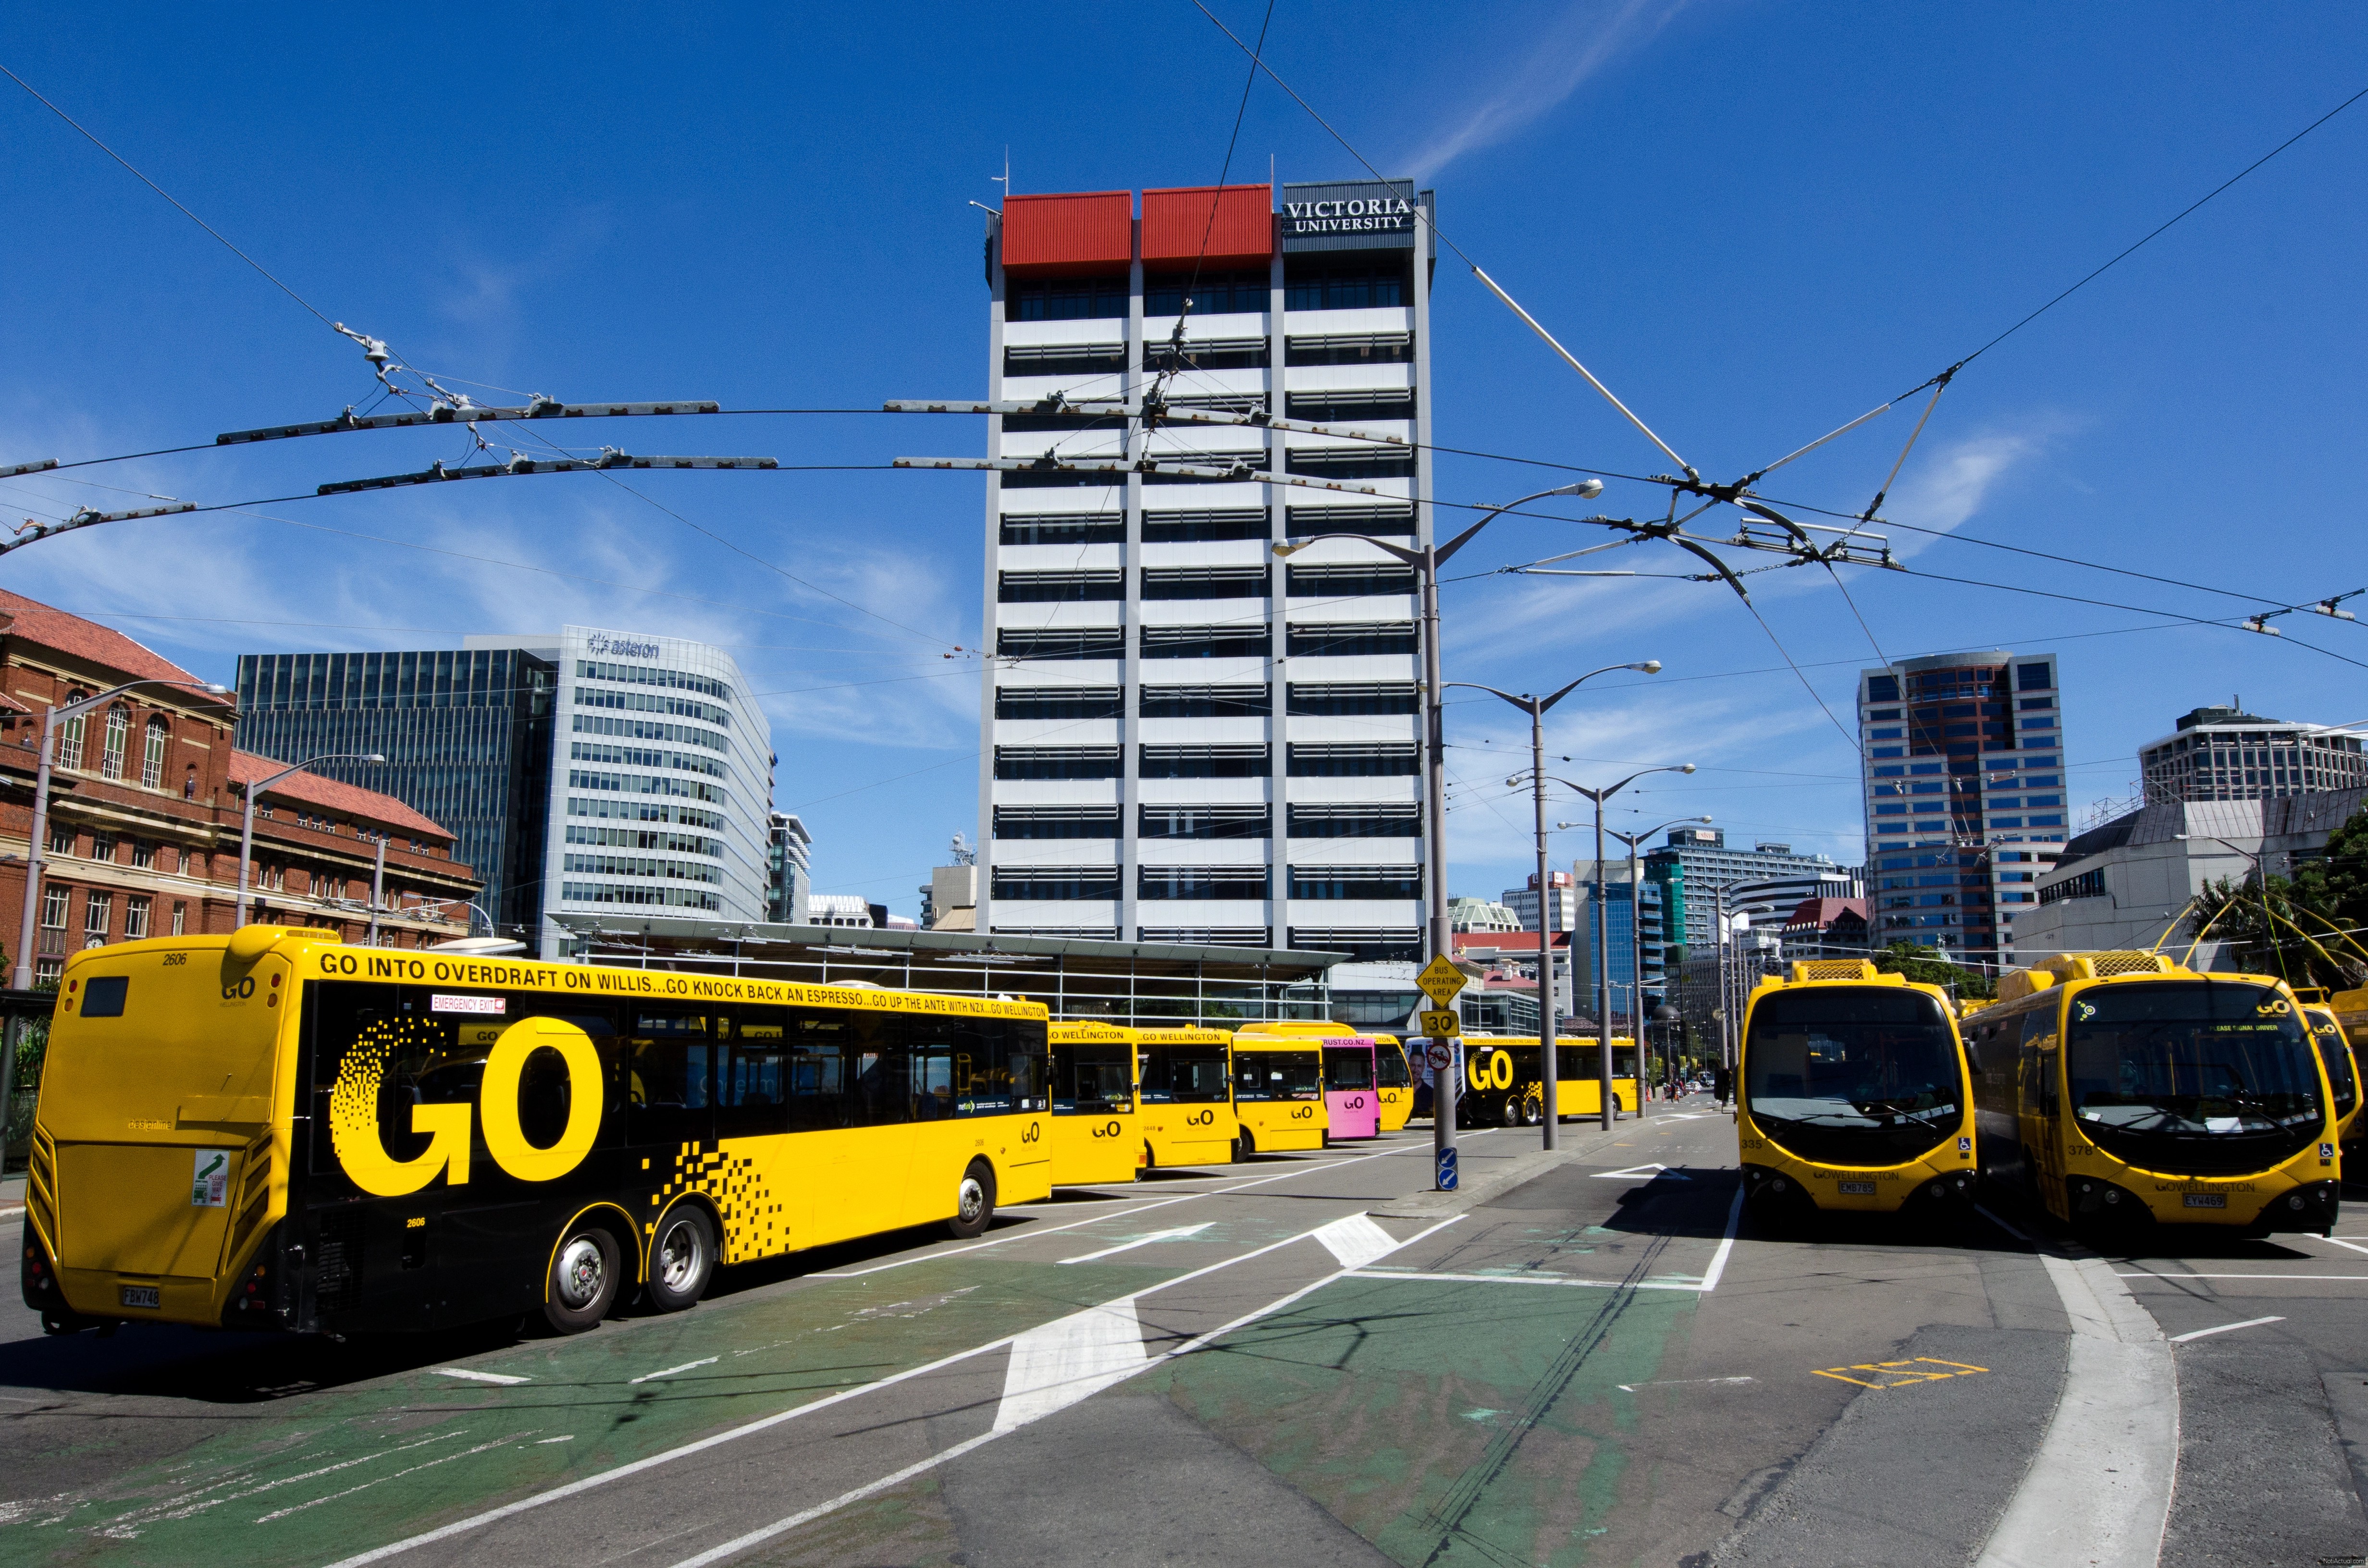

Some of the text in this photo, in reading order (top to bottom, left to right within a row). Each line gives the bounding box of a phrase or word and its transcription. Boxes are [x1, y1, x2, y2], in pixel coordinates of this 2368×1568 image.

[1286, 198, 1410, 218] VICTORIA
[1295, 217, 1403, 232] UNIVERSITY
[611, 638, 659, 659] asteron
[162, 953, 187, 966] 2606
[222, 976, 255, 999] GO
[321, 953, 358, 974] GO
[368, 957, 425, 979] INTO
[434, 962, 557, 987] OVERDRAFT
[565, 971, 591, 989] ON
[693, 980, 743, 998] KNOCK
[747, 985, 783, 1000] BACK
[787, 988, 803, 1002] AN
[889, 996, 902, 1008] UP
[904, 997, 922, 1009] THE
[925, 999, 946, 1011] ANTE
[948, 1000, 967, 1012] WITH
[1003, 1004, 1046, 1017] WELLINGTON
[1423, 977, 1461, 985] OPERATING
[1432, 988, 1451, 996] AREA
[434, 997, 493, 1011] EMERGENCY EXIT
[2257, 1000, 2291, 1014] GO
[1428, 1016, 1452, 1031] 30
[2313, 1024, 2336, 1033] GO
[477, 1031, 498, 1041] GO
[1468, 1050, 1513, 1090] GO
[1344, 1097, 1364, 1109] GO
[1379, 1092, 1397, 1103] GO
[330, 1016, 604, 1196] GO
[1291, 1106, 1312, 1119] GO
[129, 1118, 172, 1130] designline
[1186, 1109, 1214, 1126] GO
[1022, 1121, 1040, 1144] GO
[1092, 1121, 1121, 1138] GO
[1741, 1139, 1762, 1149] 335
[2068, 1145, 2093, 1156] 378
[1841, 1183, 1873, 1193] EMB785
[2186, 1196, 2222, 1206] EYW469
[407, 1217, 425, 1228] 2606
[125, 1289, 159, 1305] FBW748
